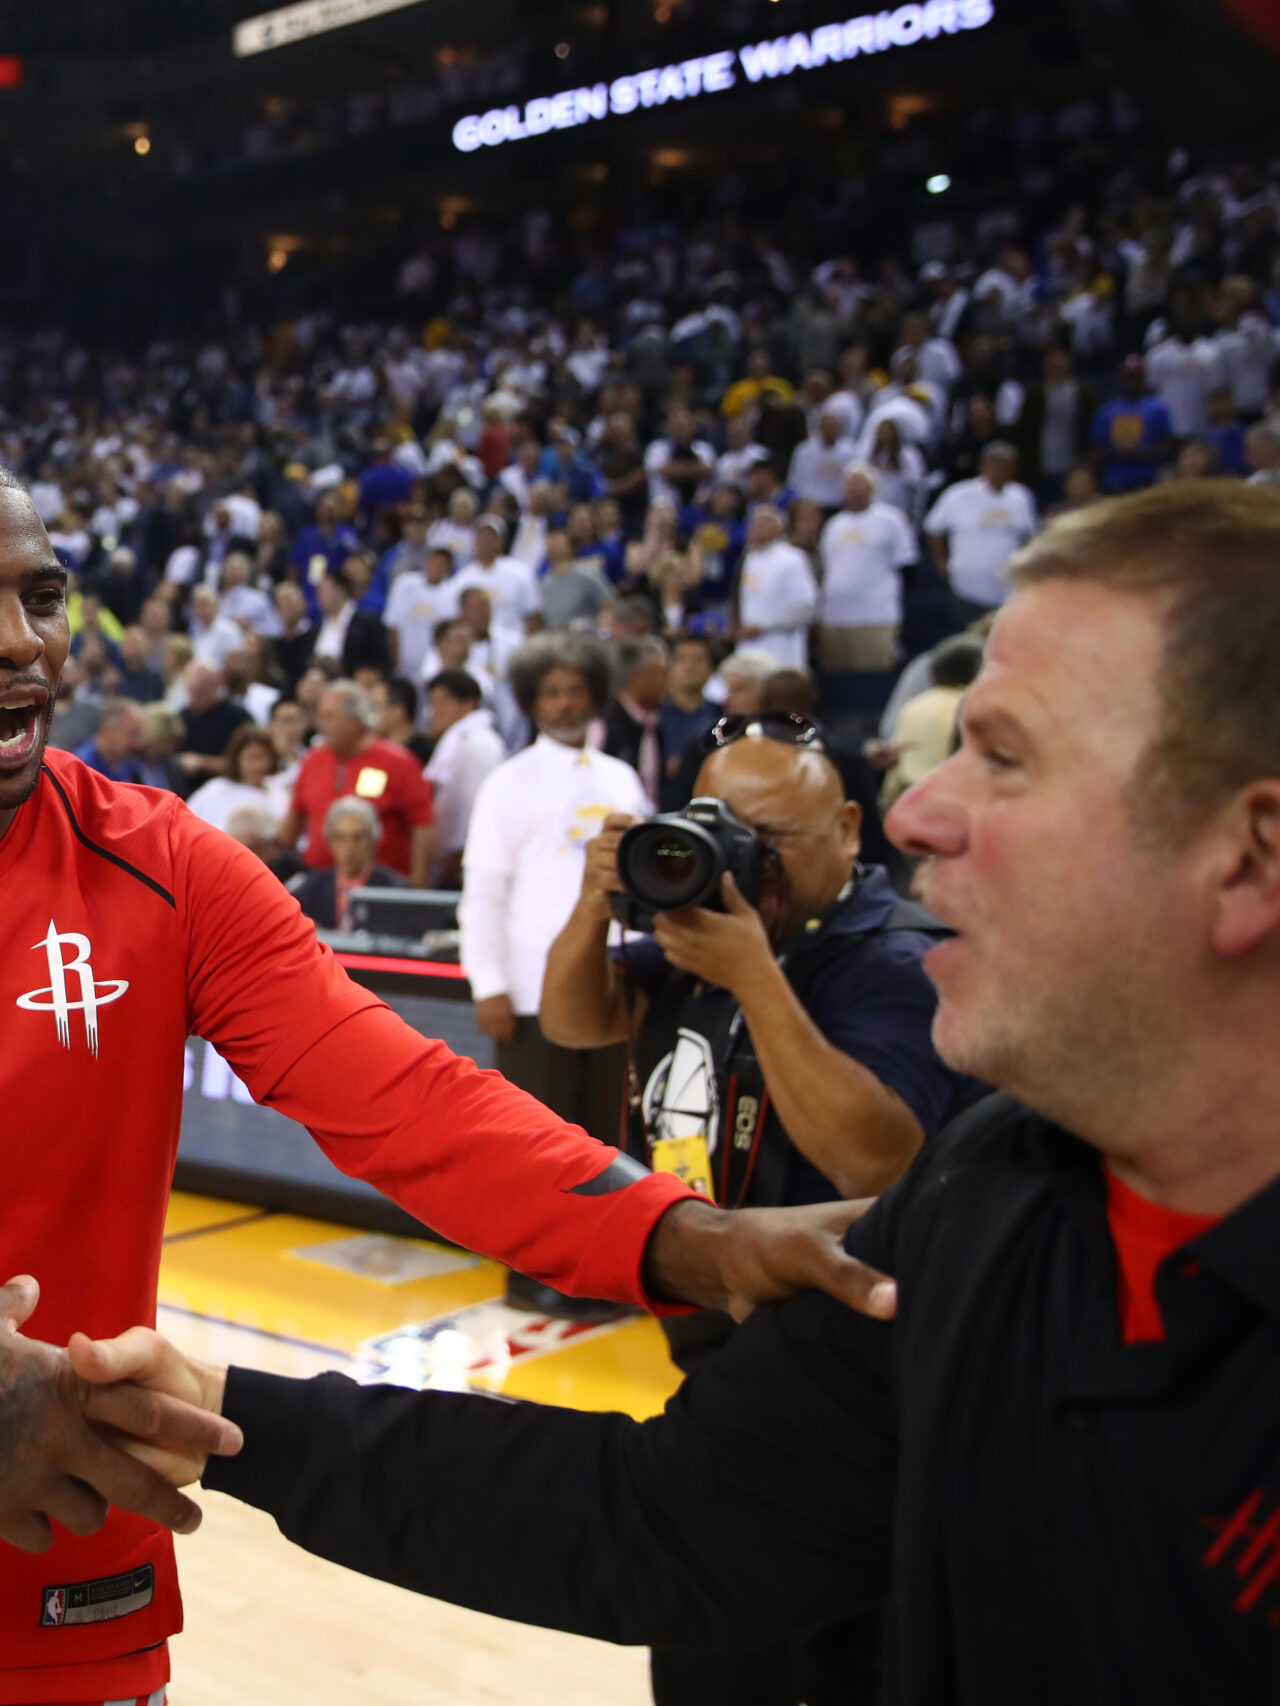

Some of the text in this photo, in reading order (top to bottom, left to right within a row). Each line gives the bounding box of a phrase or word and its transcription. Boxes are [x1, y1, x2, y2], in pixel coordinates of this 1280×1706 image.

[453, 0, 995, 152] GOLDEN STATE WARRIORS
[734, 1095, 758, 1150] EOS
